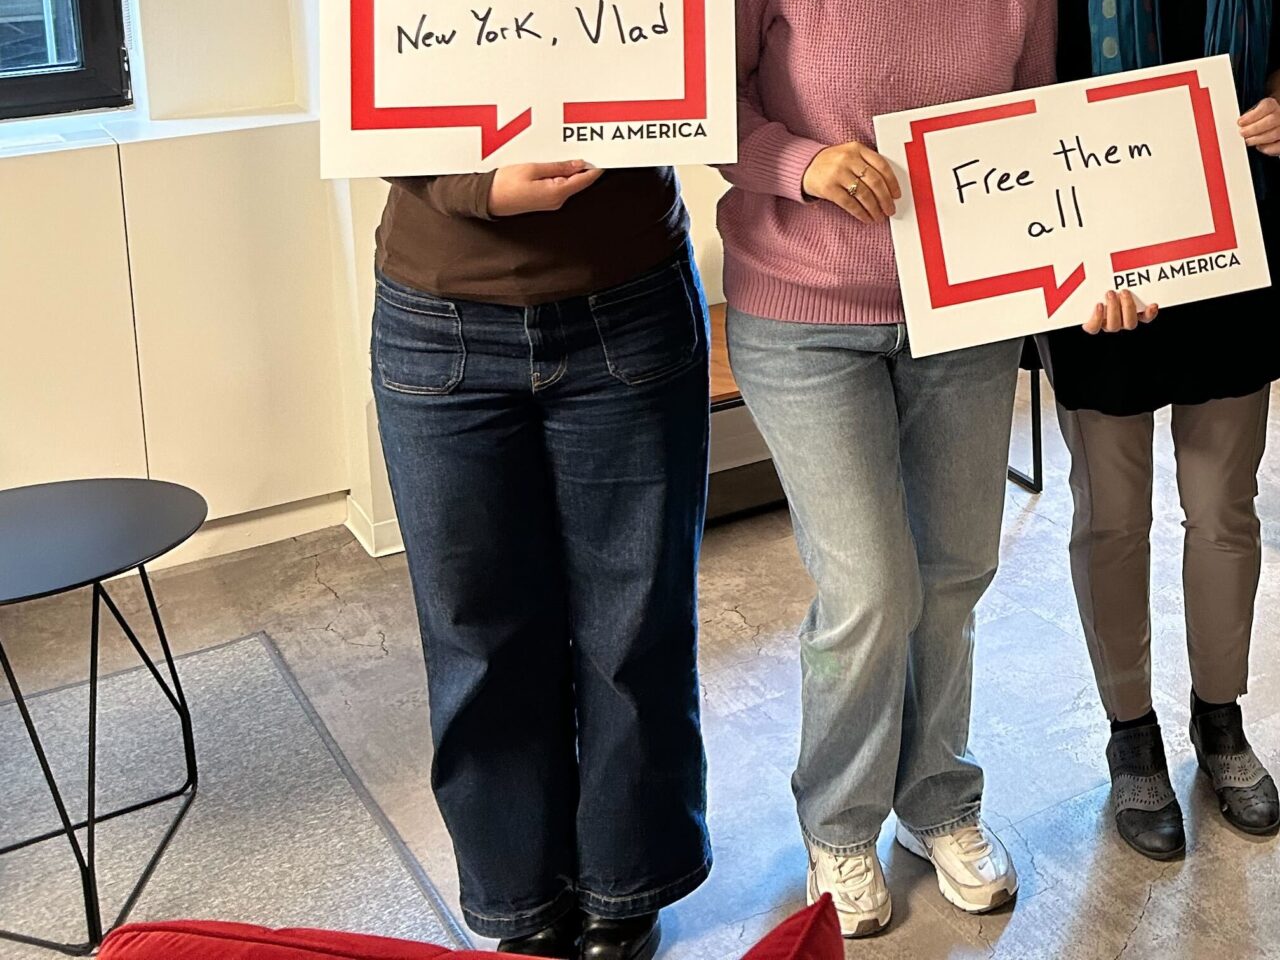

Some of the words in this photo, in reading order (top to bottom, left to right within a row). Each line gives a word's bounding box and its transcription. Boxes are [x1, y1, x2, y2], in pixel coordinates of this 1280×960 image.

[397, 13, 457, 54] New
[562, 124, 605, 143] PEN
[611, 121, 708, 140] AMERICA
[952, 158, 1035, 204] Free
[1053, 135, 1152, 171] them
[1027, 185, 1084, 238] all
[1113, 269, 1151, 291] PEN
[1157, 252, 1241, 282] AMERICA
